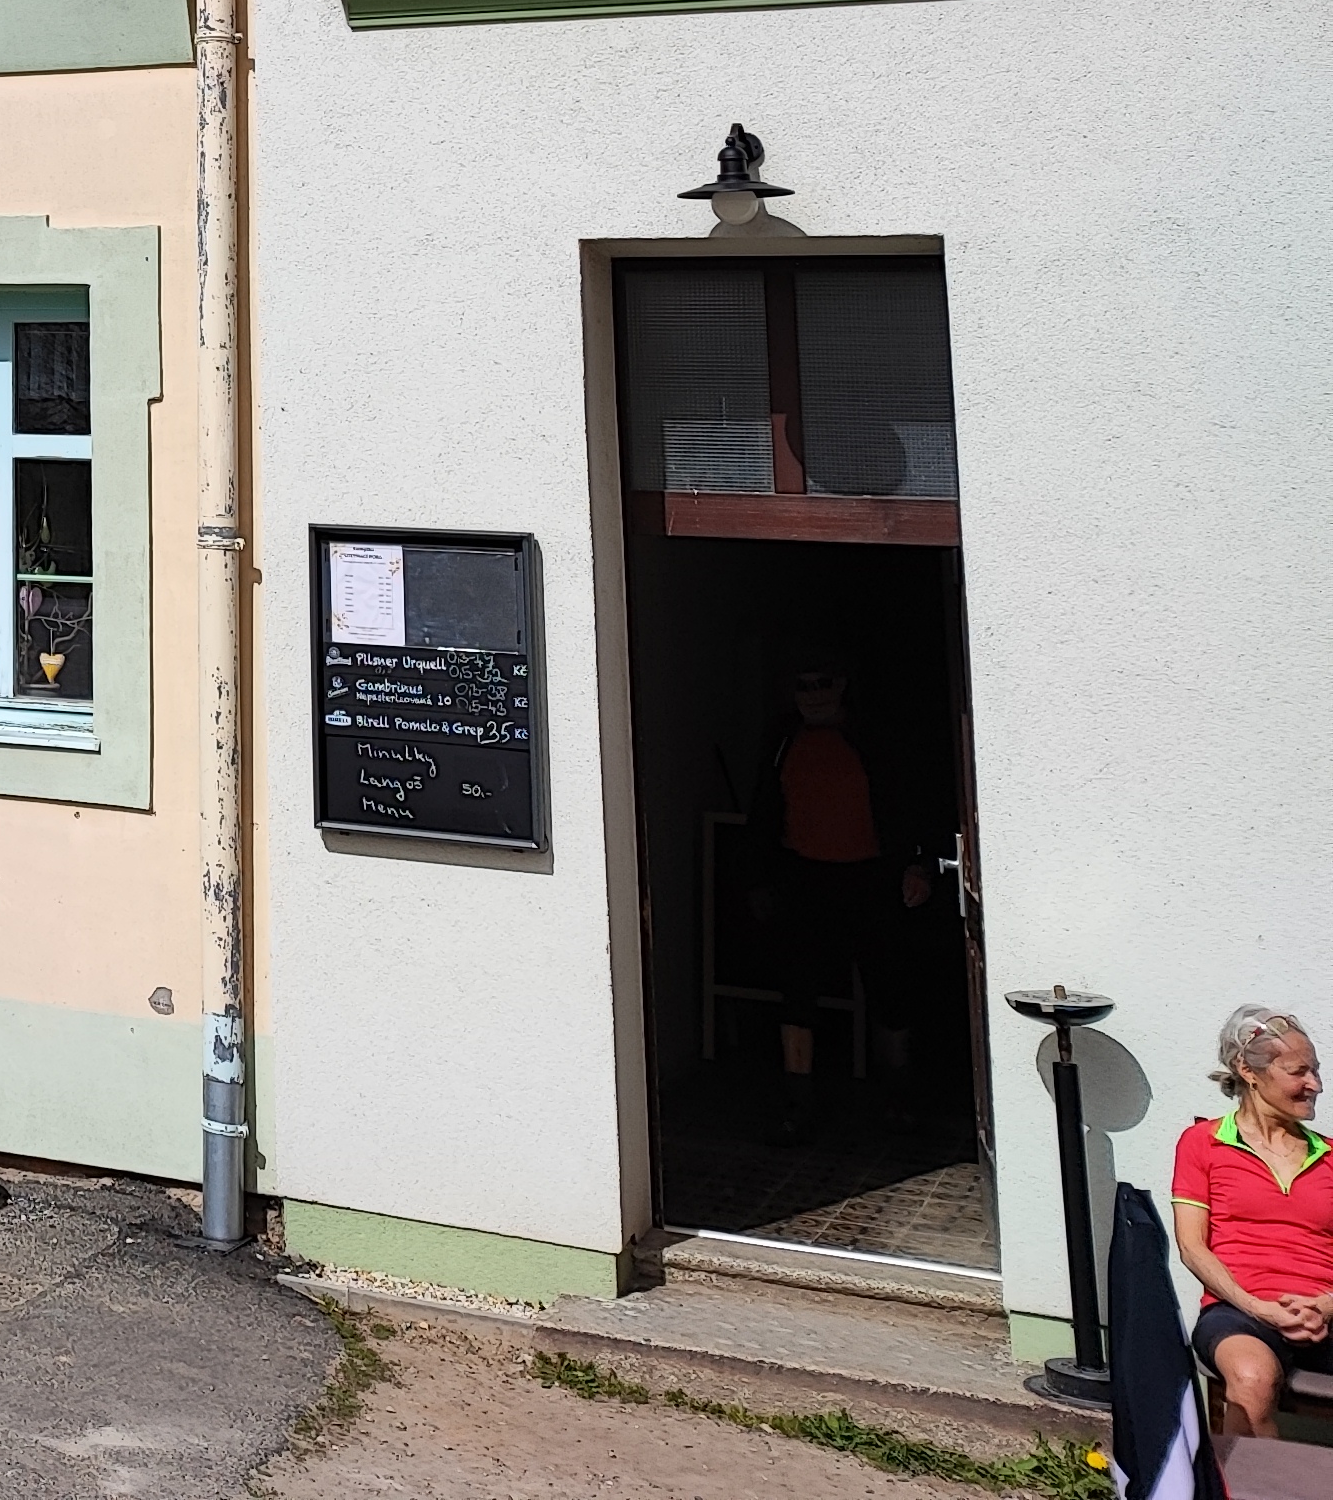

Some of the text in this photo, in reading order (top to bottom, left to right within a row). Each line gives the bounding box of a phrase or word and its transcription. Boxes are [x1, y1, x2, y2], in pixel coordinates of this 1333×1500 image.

[356, 652, 399, 668] Pilsner
[402, 656, 447, 675] Urquell
[512, 664, 529, 677] Kč
[356, 678, 423, 695] Gambrinus
[514, 697, 529, 709] Kč
[356, 715, 390, 728] Birell
[395, 717, 439, 732] Pomelo
[441, 721, 450, 736] &
[452, 721, 484, 741] Grep
[514, 728, 530, 740] Kč
[362, 796, 415, 819] Menu
